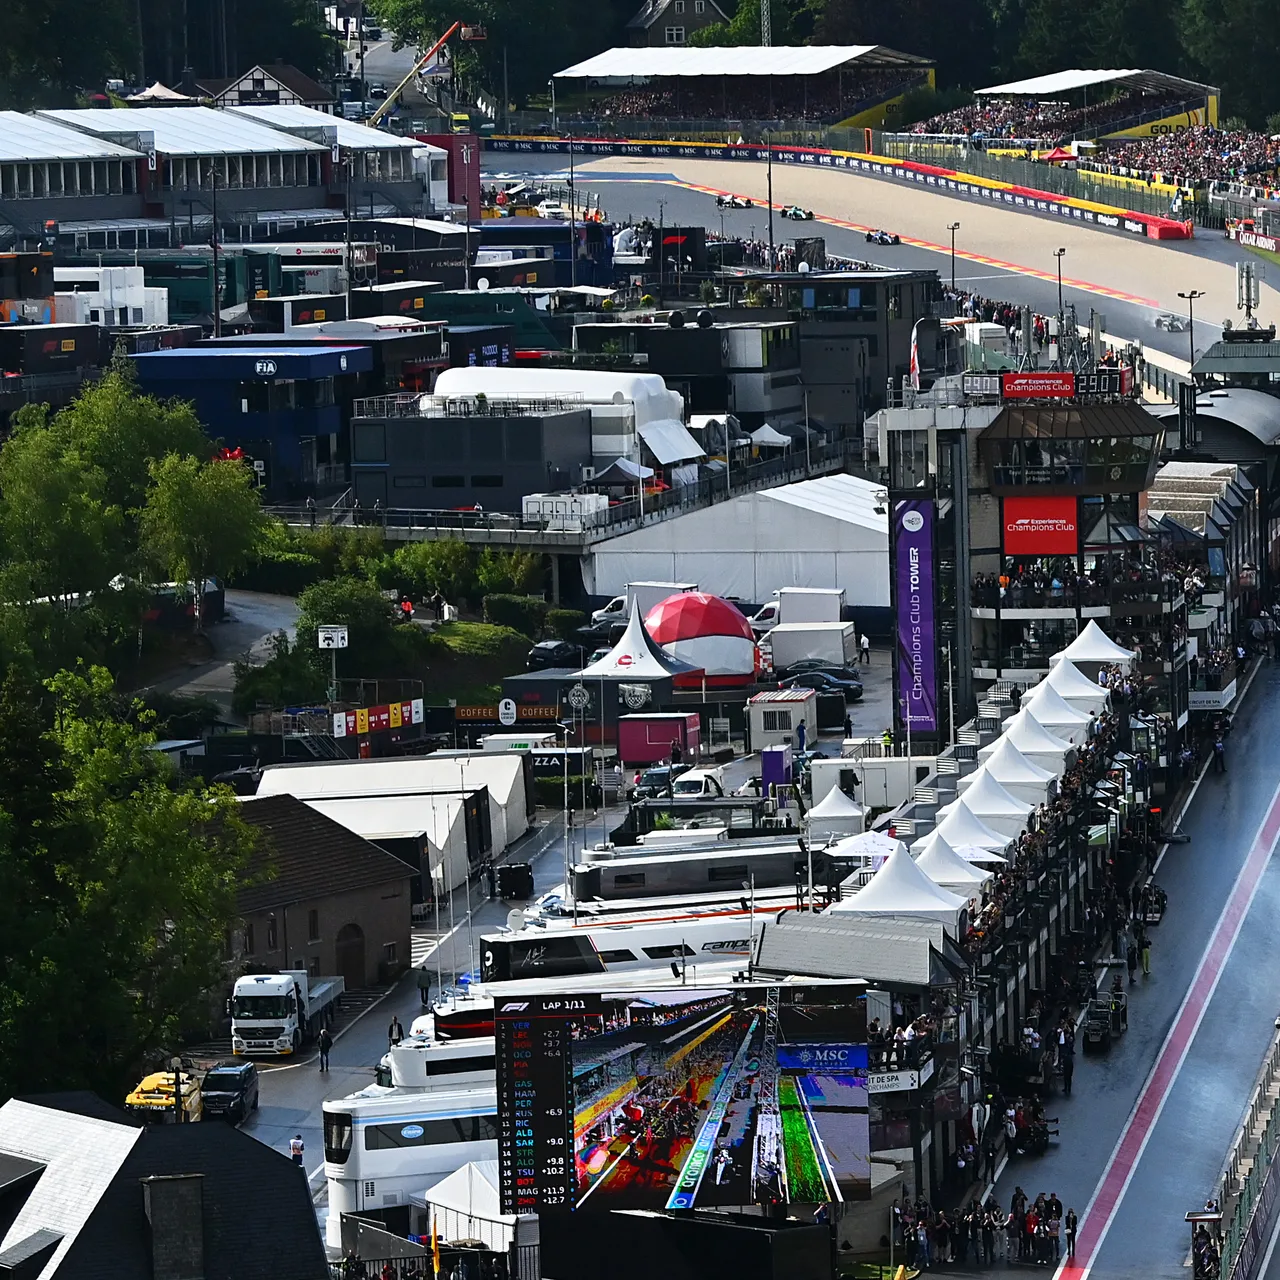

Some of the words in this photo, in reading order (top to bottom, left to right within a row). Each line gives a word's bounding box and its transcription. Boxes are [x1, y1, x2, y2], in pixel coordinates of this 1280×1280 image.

[1005, 383, 1051, 392] Champions
[1052, 383, 1071, 391] Club
[1007, 523, 1054, 532] Champions
[1055, 523, 1075, 531] Club
[910, 547, 919, 593] TOWER
[910, 595, 921, 624] Club
[912, 626, 922, 700] Champions
[461, 708, 493, 717] COFFEE
[522, 707, 555, 716] COFFEE
[542, 1002, 561, 1010] LAP
[564, 1000, 586, 1010] 1/11
[543, 1030, 560, 1038] +2.7
[544, 1040, 560, 1048] +3.7
[815, 1049, 849, 1062] MSC
[875, 1075, 885, 1084] DE
[885, 1074, 899, 1083] SPA
[514, 1080, 533, 1088] GAS
[514, 1090, 537, 1098] HAM
[515, 1100, 532, 1108] PER
[545, 1108, 563, 1116] +6.9
[515, 1119, 529, 1127] RIC
[516, 1129, 533, 1137] ALB
[516, 1139, 534, 1147] SAR
[546, 1137, 564, 1145] +9.0
[516, 1158, 535, 1166] ALO
[546, 1157, 564, 1165] +9.8
[516, 1168, 535, 1176] TSU
[541, 1167, 565, 1175] +10.2
[681, 1152, 705, 1188] aramco
[542, 1186, 565, 1194] +11.9
[542, 1196, 565, 1204] +12.7
